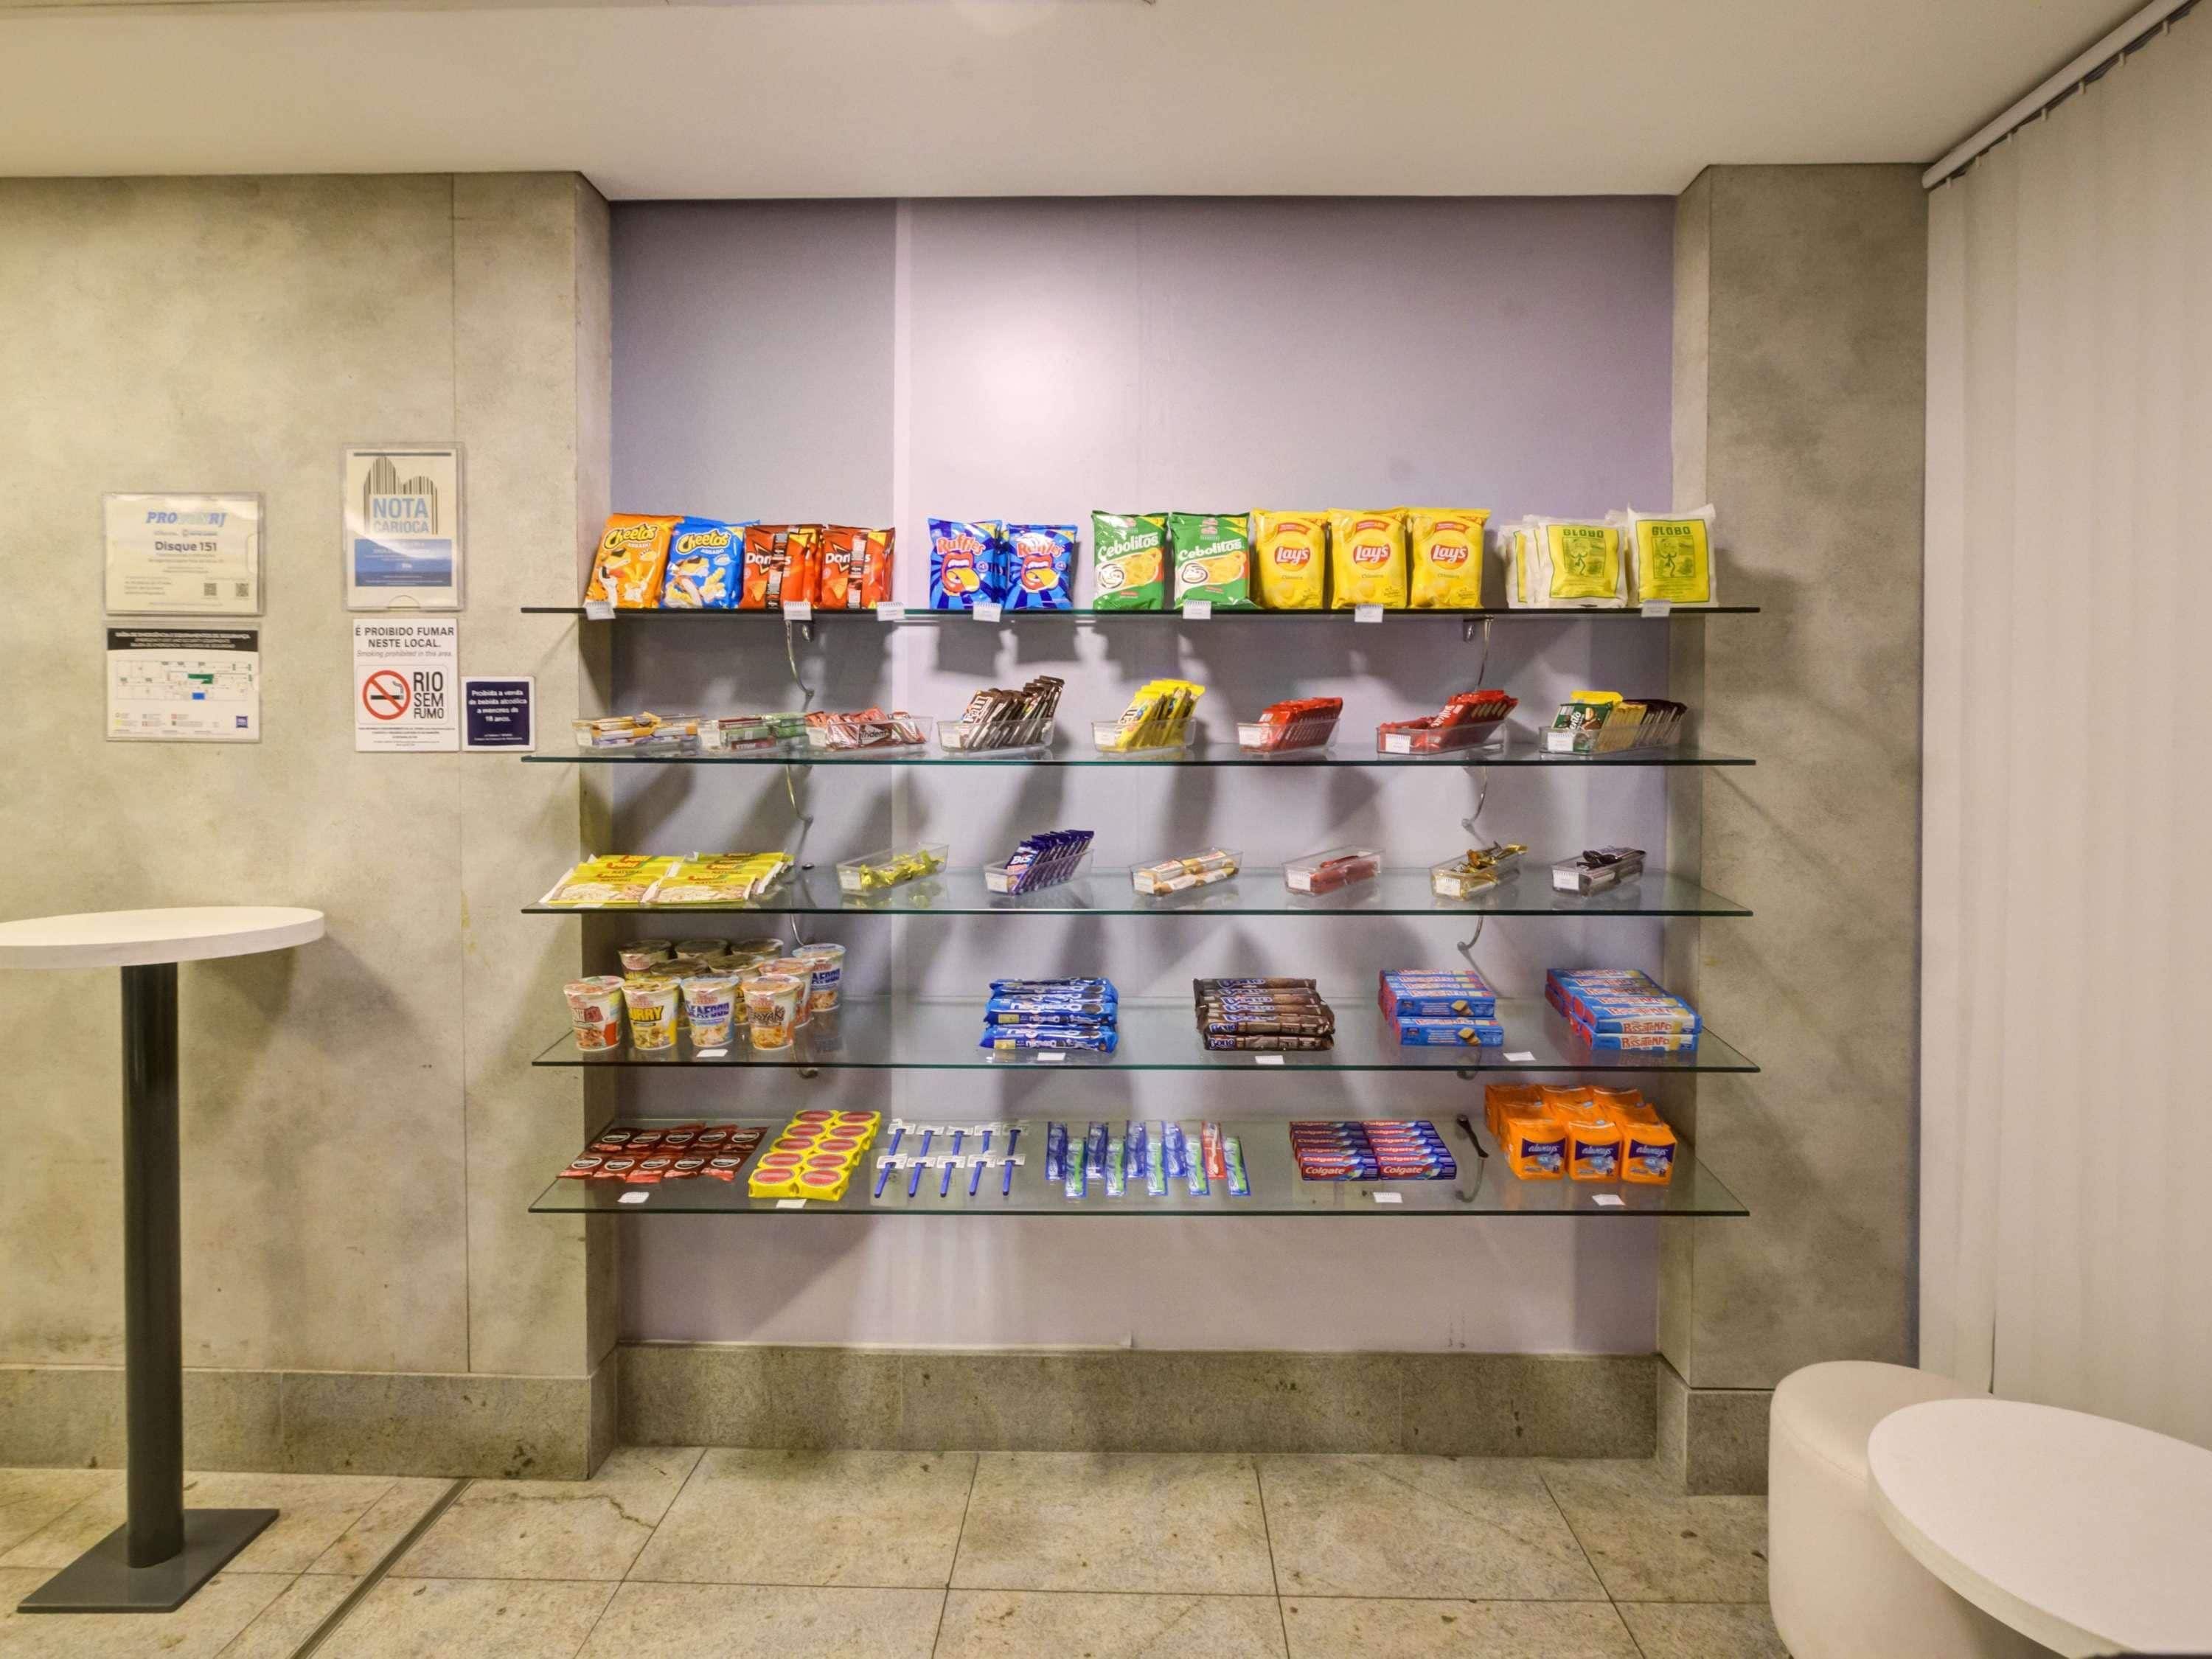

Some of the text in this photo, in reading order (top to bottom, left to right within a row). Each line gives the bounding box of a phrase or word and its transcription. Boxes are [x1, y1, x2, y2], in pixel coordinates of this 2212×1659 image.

[373, 498, 428, 518] NOTA
[373, 521, 429, 534] CARIOCA
[1563, 529, 1604, 538] GLOBO
[1652, 526, 1691, 535] GLOBO
[604, 524, 658, 549] Cheetos
[677, 529, 731, 554] Cheetos
[155, 541, 217, 552] Disque 151
[936, 533, 986, 555] Ruffles
[1098, 532, 1159, 561] Cebolitos
[1179, 538, 1242, 560] Cebolitos
[825, 552, 871, 564] Doris
[364, 627, 414, 636] PROIBIDO
[417, 627, 454, 636] FUMAR
[368, 639, 400, 647] NESTE
[413, 672, 443, 692] RIO
[414, 692, 444, 707] SEM
[414, 708, 444, 719] FUMO
[1528, 1144, 1561, 1155] always
[1582, 1145, 1614, 1157] always
[1636, 1144, 1668, 1158] always
[1305, 1166, 1345, 1176] Colgate
[1383, 1165, 1423, 1175] Colgate
